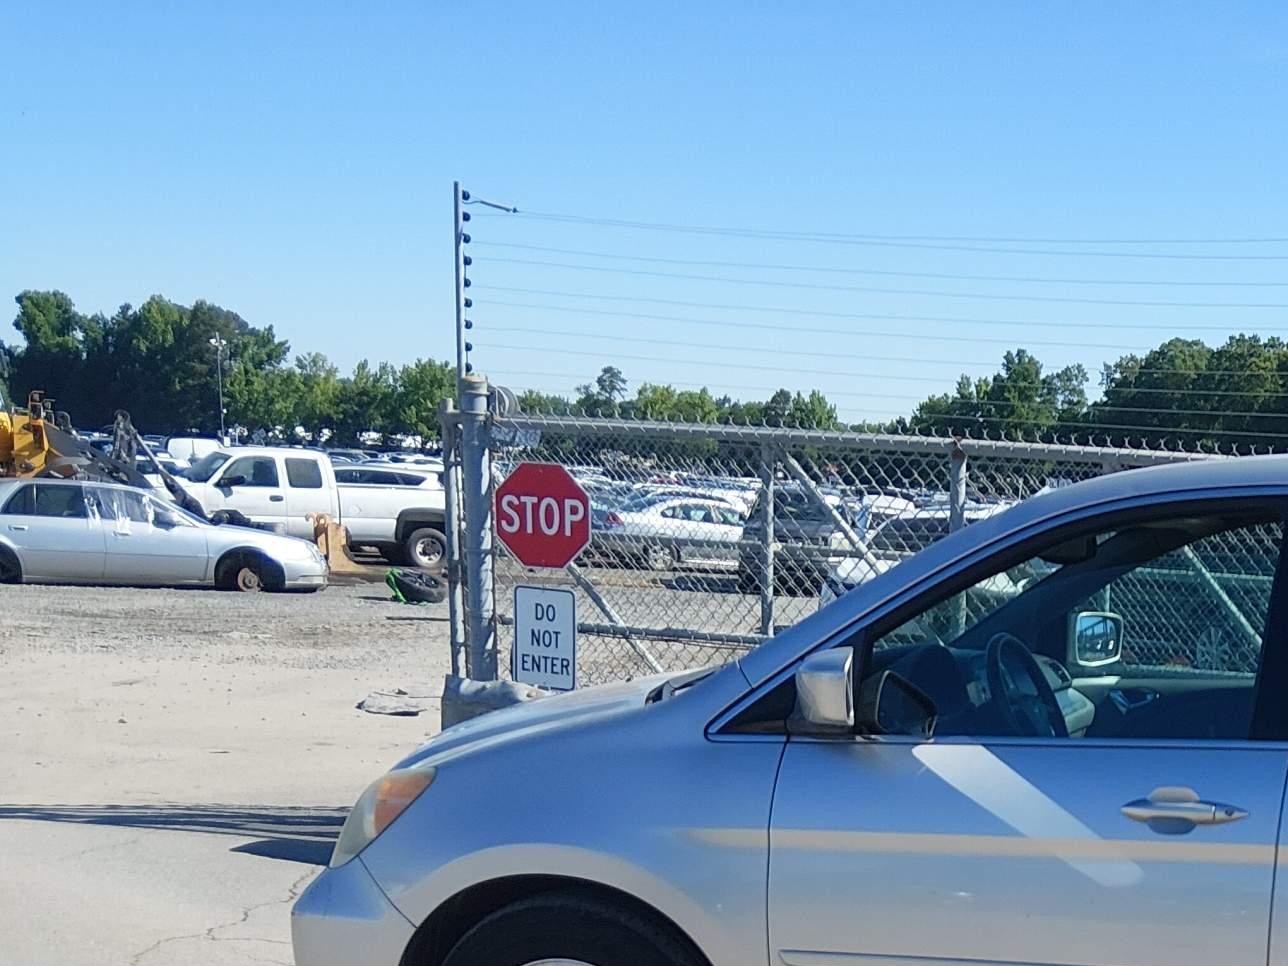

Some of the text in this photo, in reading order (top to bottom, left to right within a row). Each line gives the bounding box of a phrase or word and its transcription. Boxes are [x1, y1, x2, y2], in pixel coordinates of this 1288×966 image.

[500, 494, 585, 537] STOP
[535, 602, 556, 622] DO
[530, 629, 561, 649] NOT
[521, 653, 570, 676] ENTER
